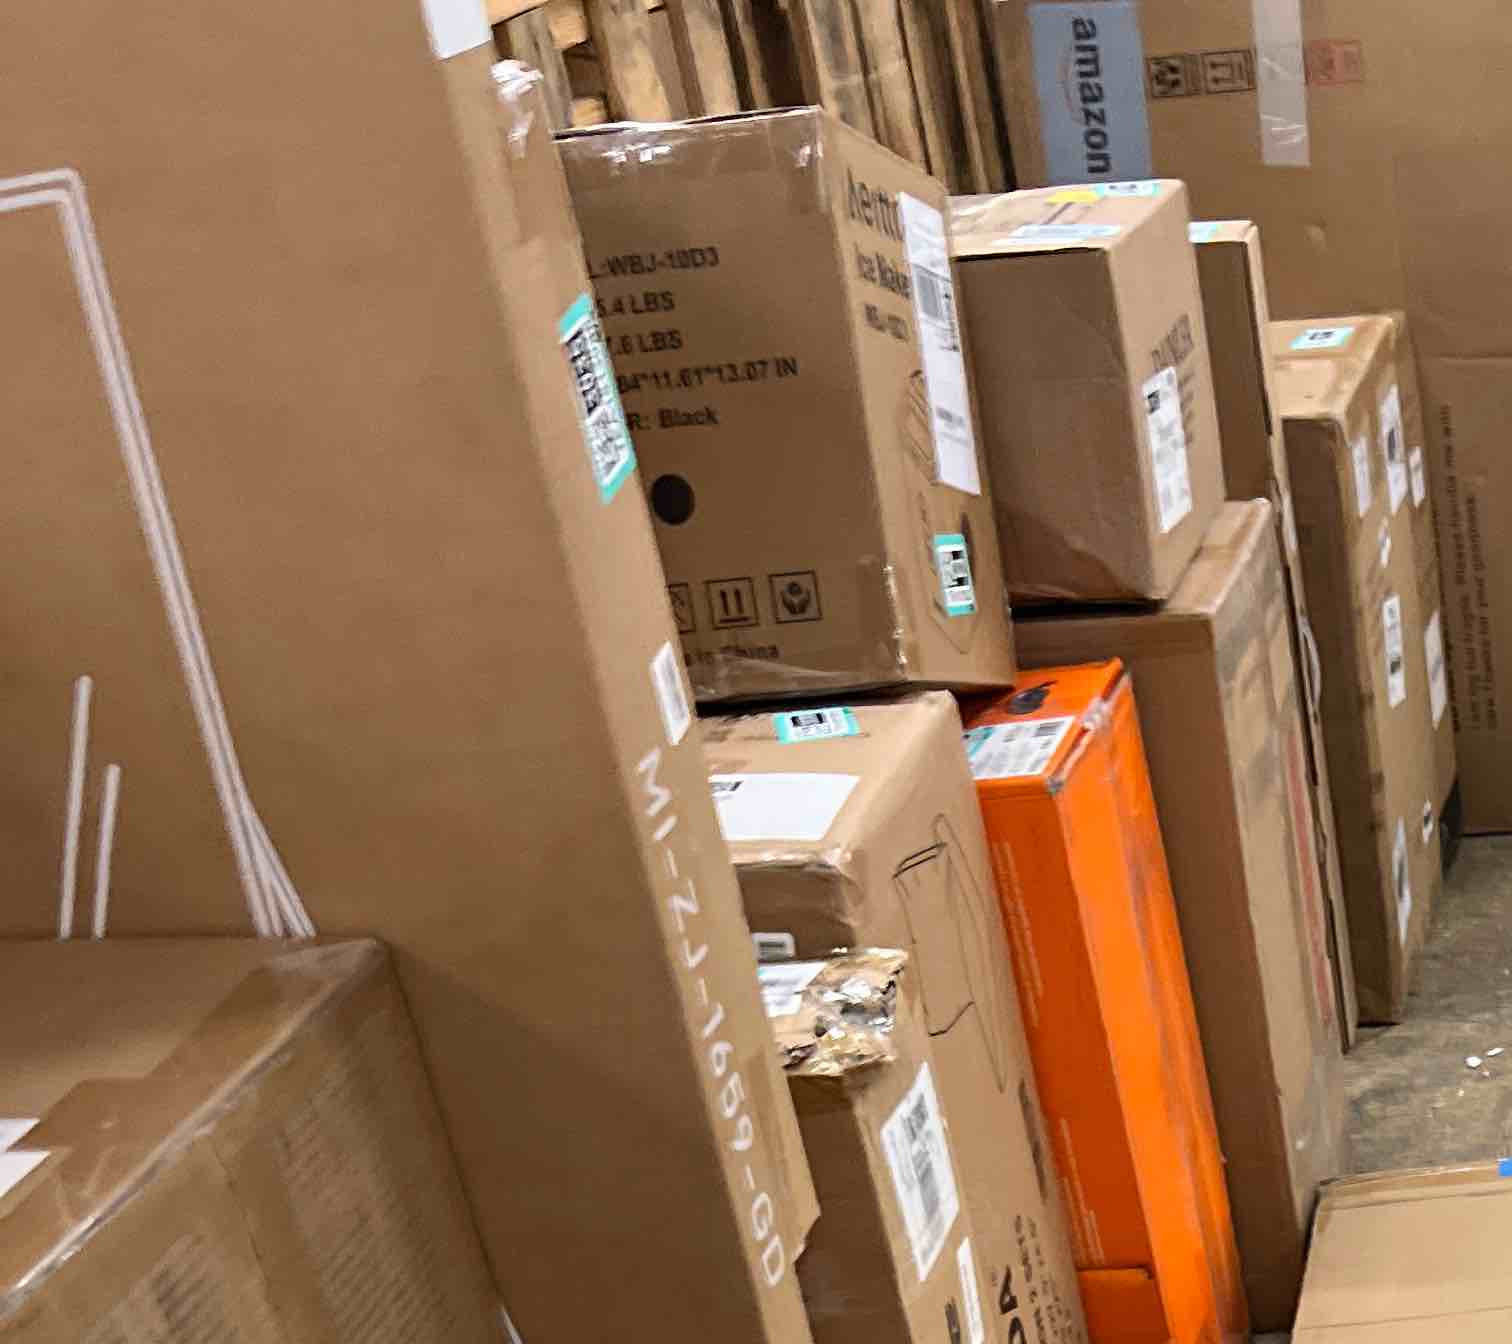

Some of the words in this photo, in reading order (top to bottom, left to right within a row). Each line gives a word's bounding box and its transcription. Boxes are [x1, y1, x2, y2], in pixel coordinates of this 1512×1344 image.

[1072, 16, 1112, 174] amazon
[631, 291, 676, 315] LBS
[638, 330, 683, 353] LBS
[775, 357, 799, 379] IN
[658, 406, 720, 428] Black
